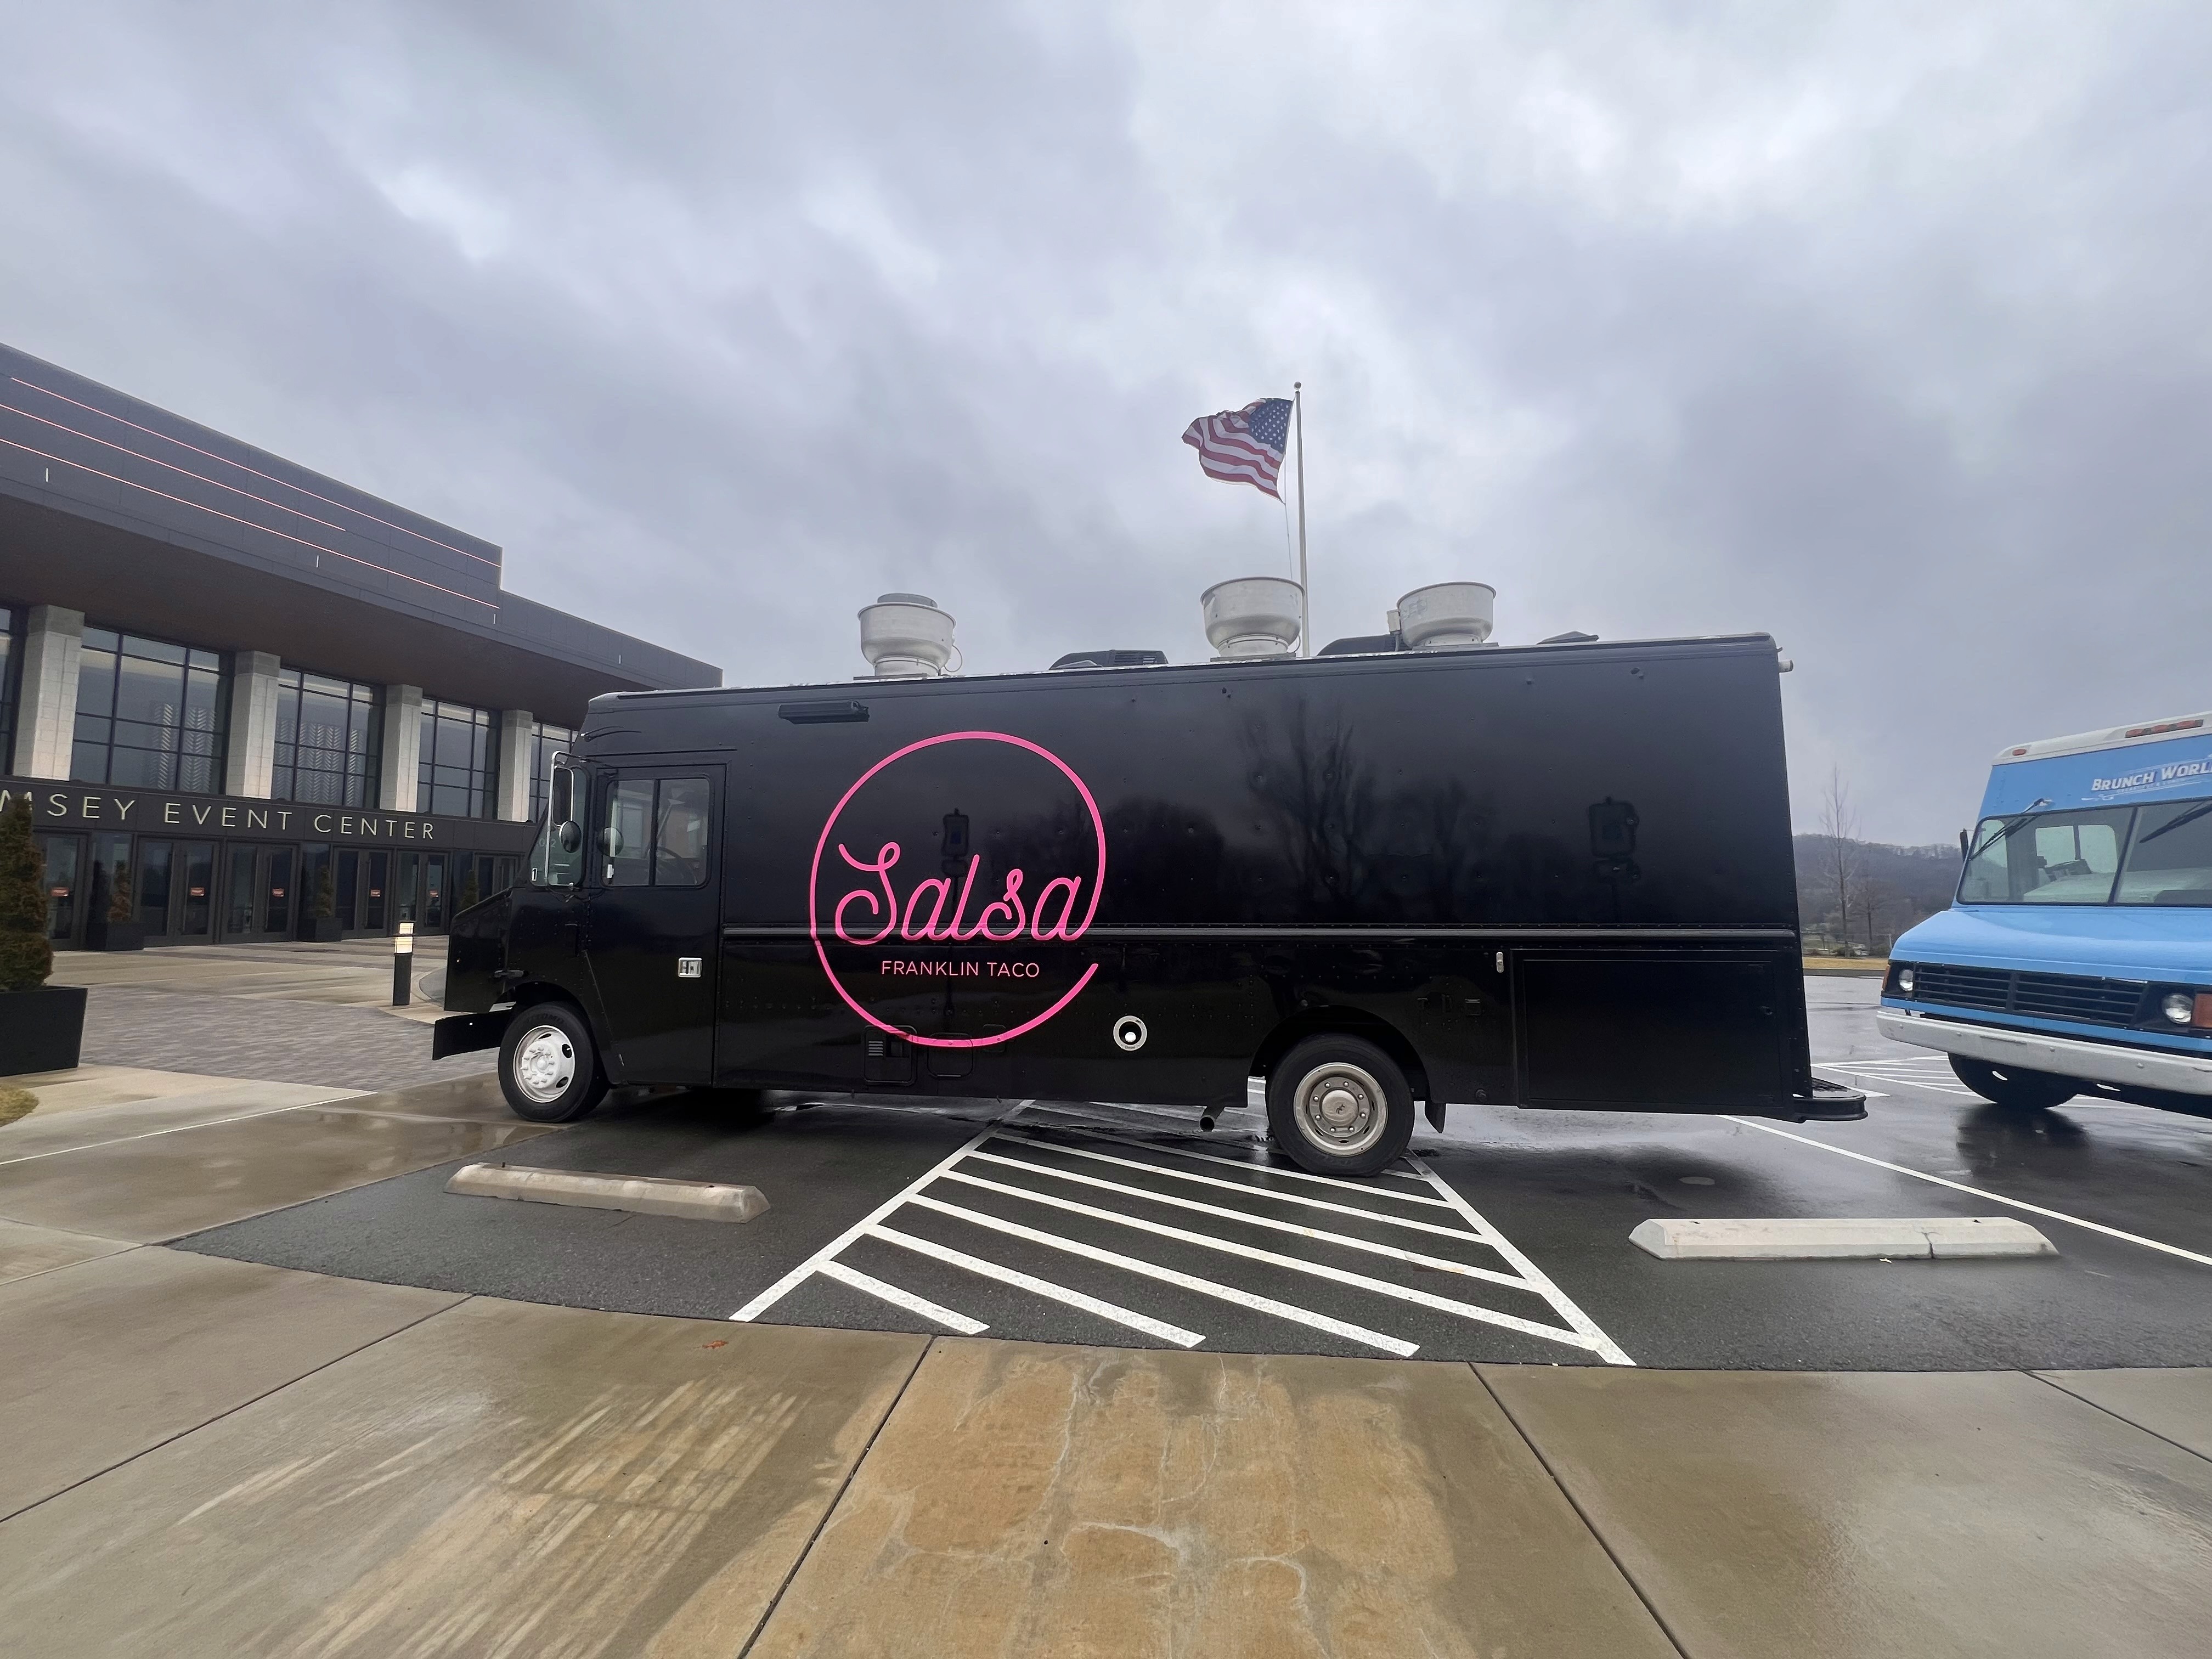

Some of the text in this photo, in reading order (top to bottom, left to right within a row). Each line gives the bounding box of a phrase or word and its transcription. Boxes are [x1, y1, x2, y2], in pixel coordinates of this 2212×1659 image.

[2091, 771, 2155, 791] BRUNCH
[2160, 761, 2212, 780] WORL
[164, 803, 292, 830] EVENT
[314, 814, 434, 840] CENTER
[835, 842, 1089, 945] Salsa
[881, 961, 1040, 978] FRANKLIN TACO
